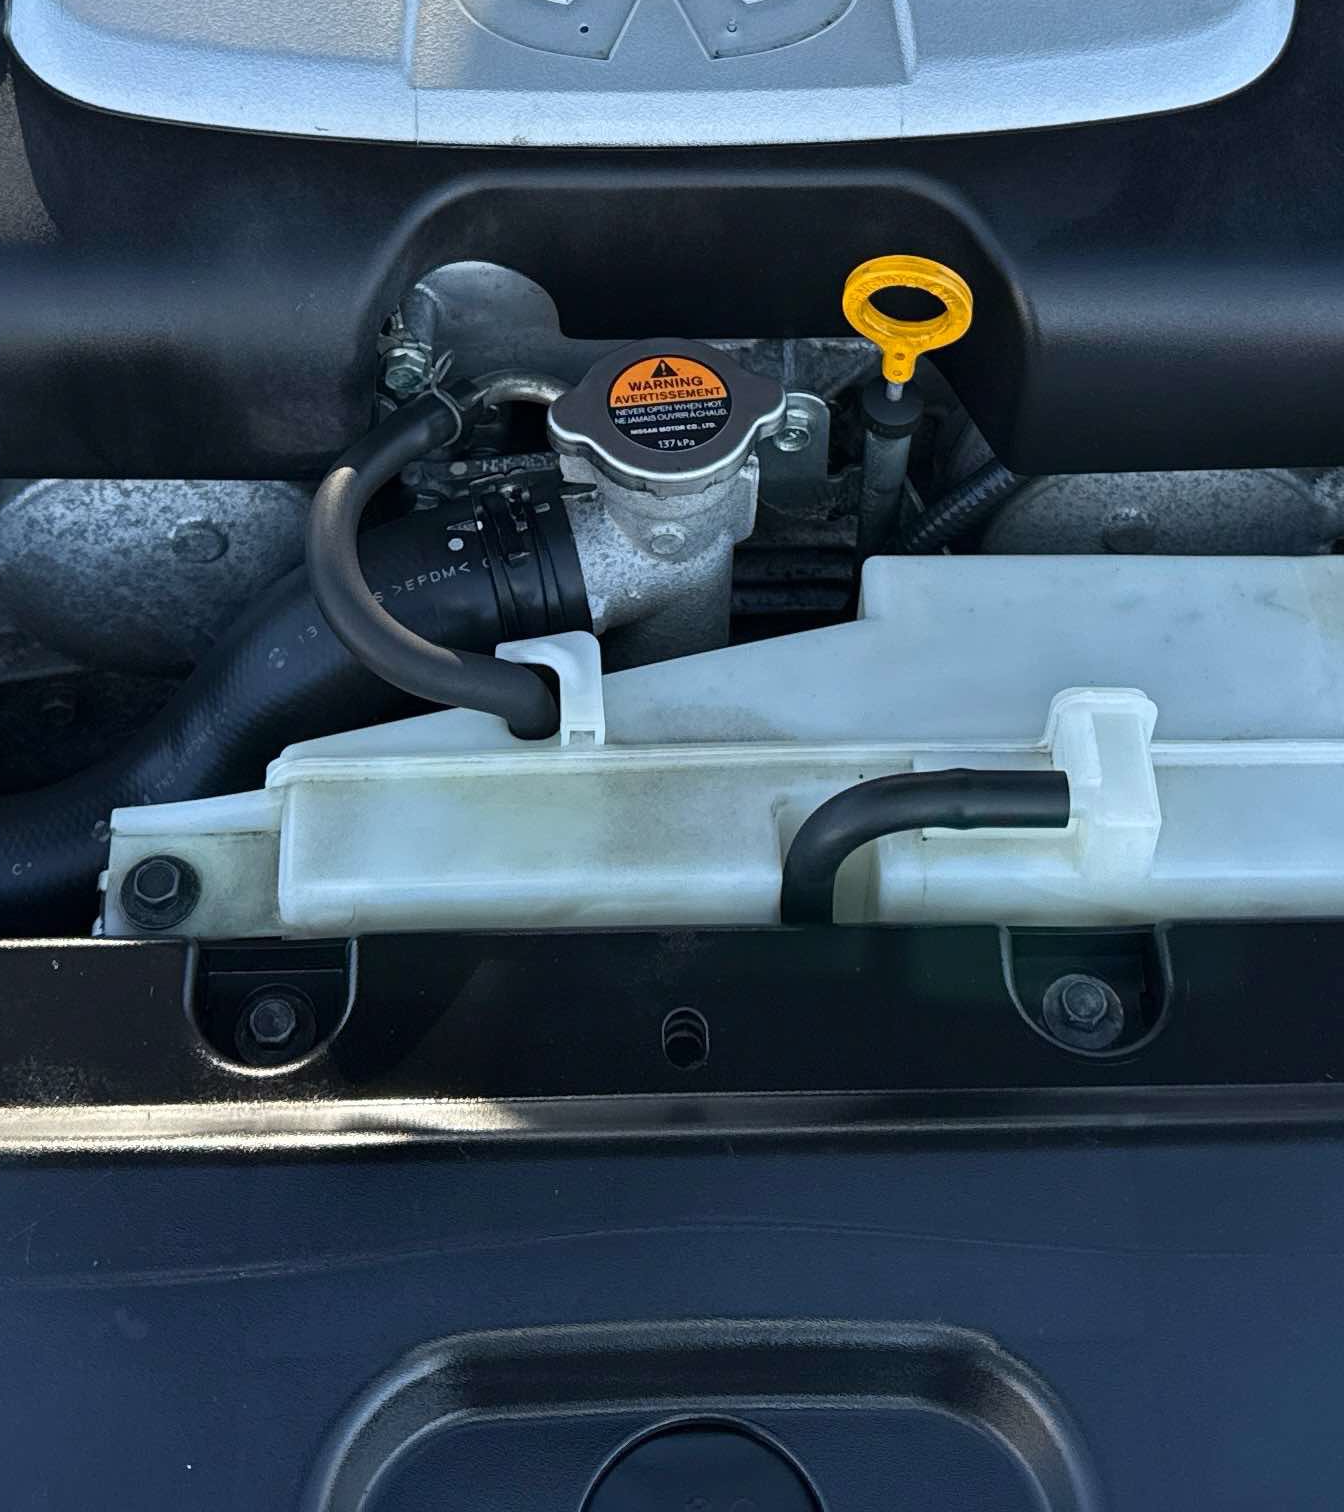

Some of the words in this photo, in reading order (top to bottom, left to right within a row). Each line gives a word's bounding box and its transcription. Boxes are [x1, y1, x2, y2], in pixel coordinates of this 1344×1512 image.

[628, 376, 704, 392] WARNING
[614, 387, 721, 405] AVERTISSEMENT
[616, 407, 645, 416] NEVER
[647, 405, 673, 414] OPEN
[674, 402, 702, 412] WHEN
[703, 400, 722, 408] HOT
[627, 414, 657, 424] JAMAIS
[657, 411, 689, 421] OUVRIR
[659, 425, 686, 433] MOTOR
[657, 439, 675, 448] 137
[677, 438, 696, 447] kPa
